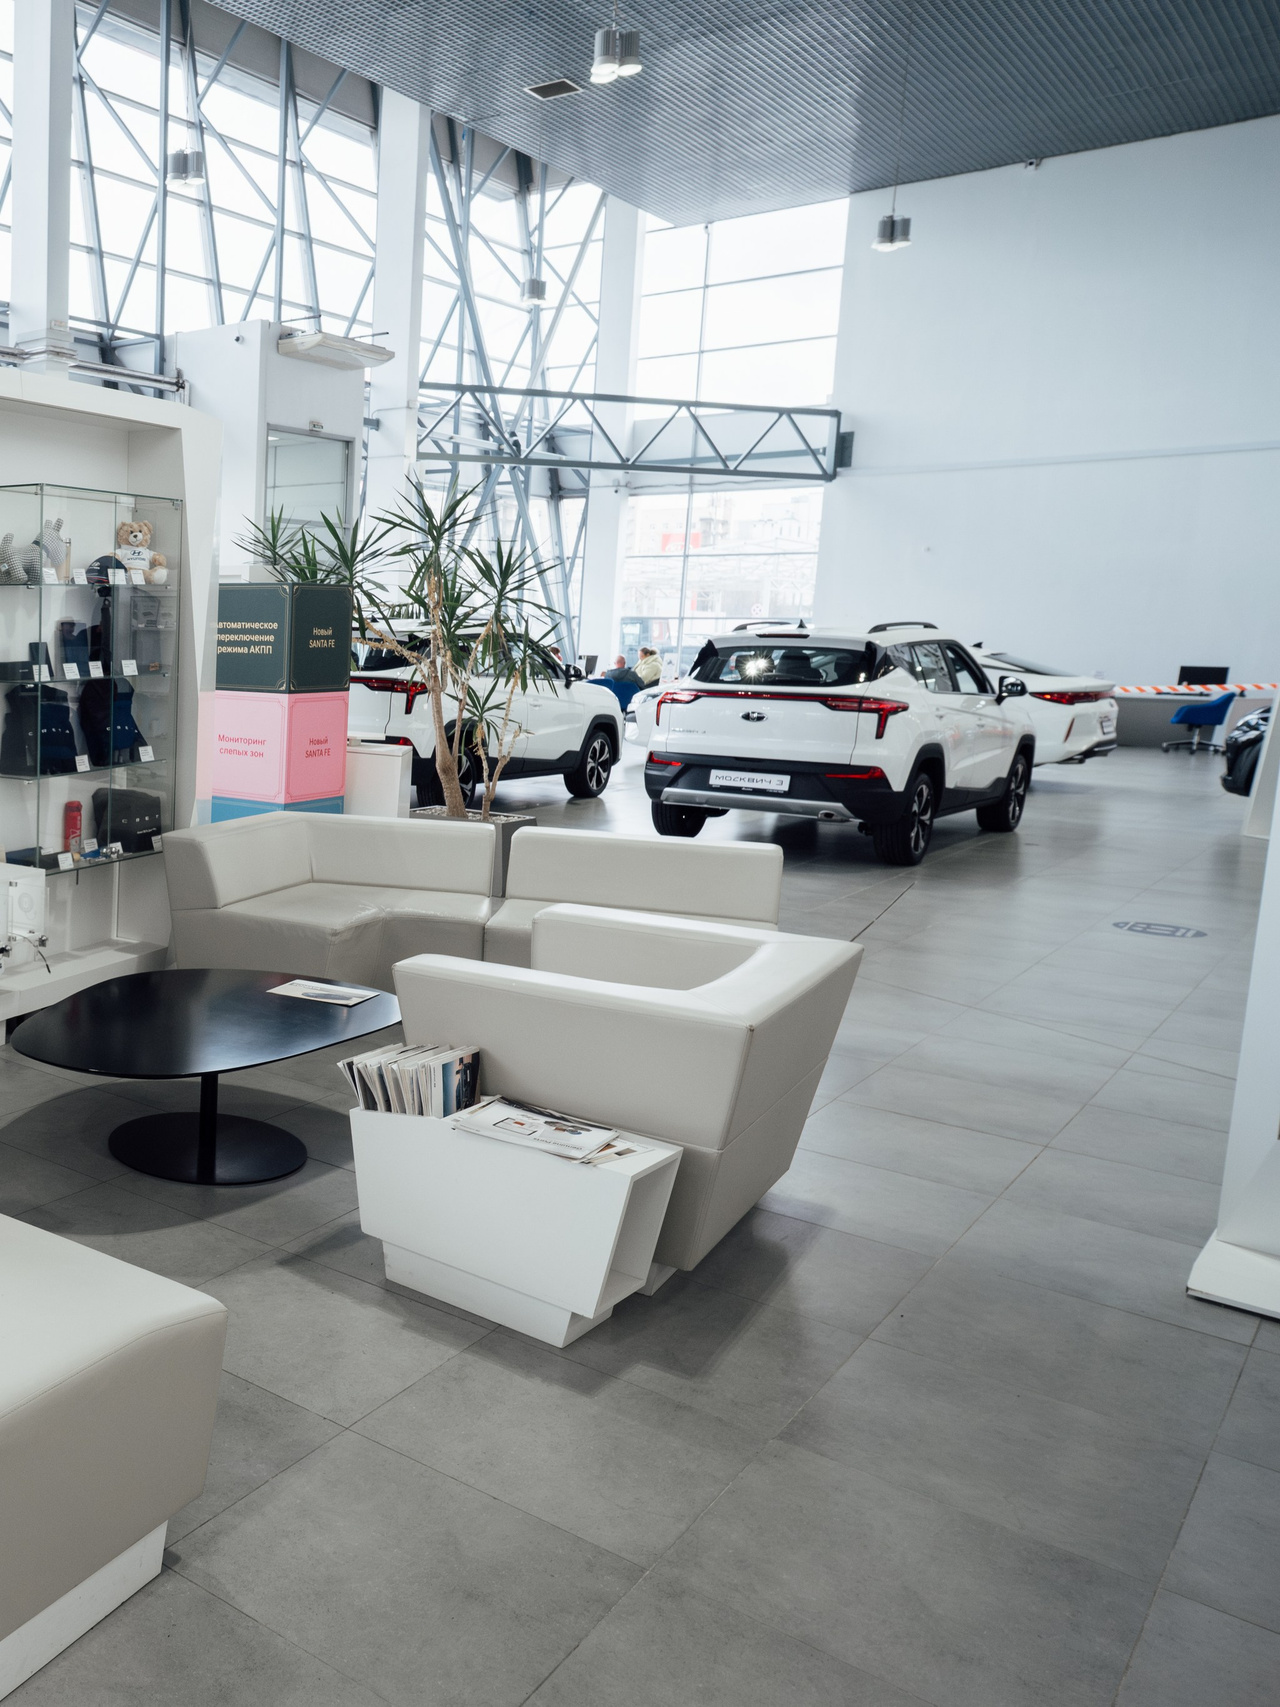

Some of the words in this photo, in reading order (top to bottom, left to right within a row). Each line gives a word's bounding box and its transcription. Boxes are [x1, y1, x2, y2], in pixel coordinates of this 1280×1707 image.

[312, 627, 333, 636] Новый
[216, 633, 275, 642] переключение
[309, 639, 328, 648] SANTA
[328, 639, 336, 648] FE
[217, 646, 248, 654] режима
[249, 645, 272, 655] АКПП
[218, 734, 267, 746] Мониторинг
[309, 736, 329, 746] Новый
[219, 747, 249, 758] слепых
[305, 749, 323, 758] SANTA
[323, 748, 331, 757] FE
[715, 775, 772, 785] МОСКВИЧ
